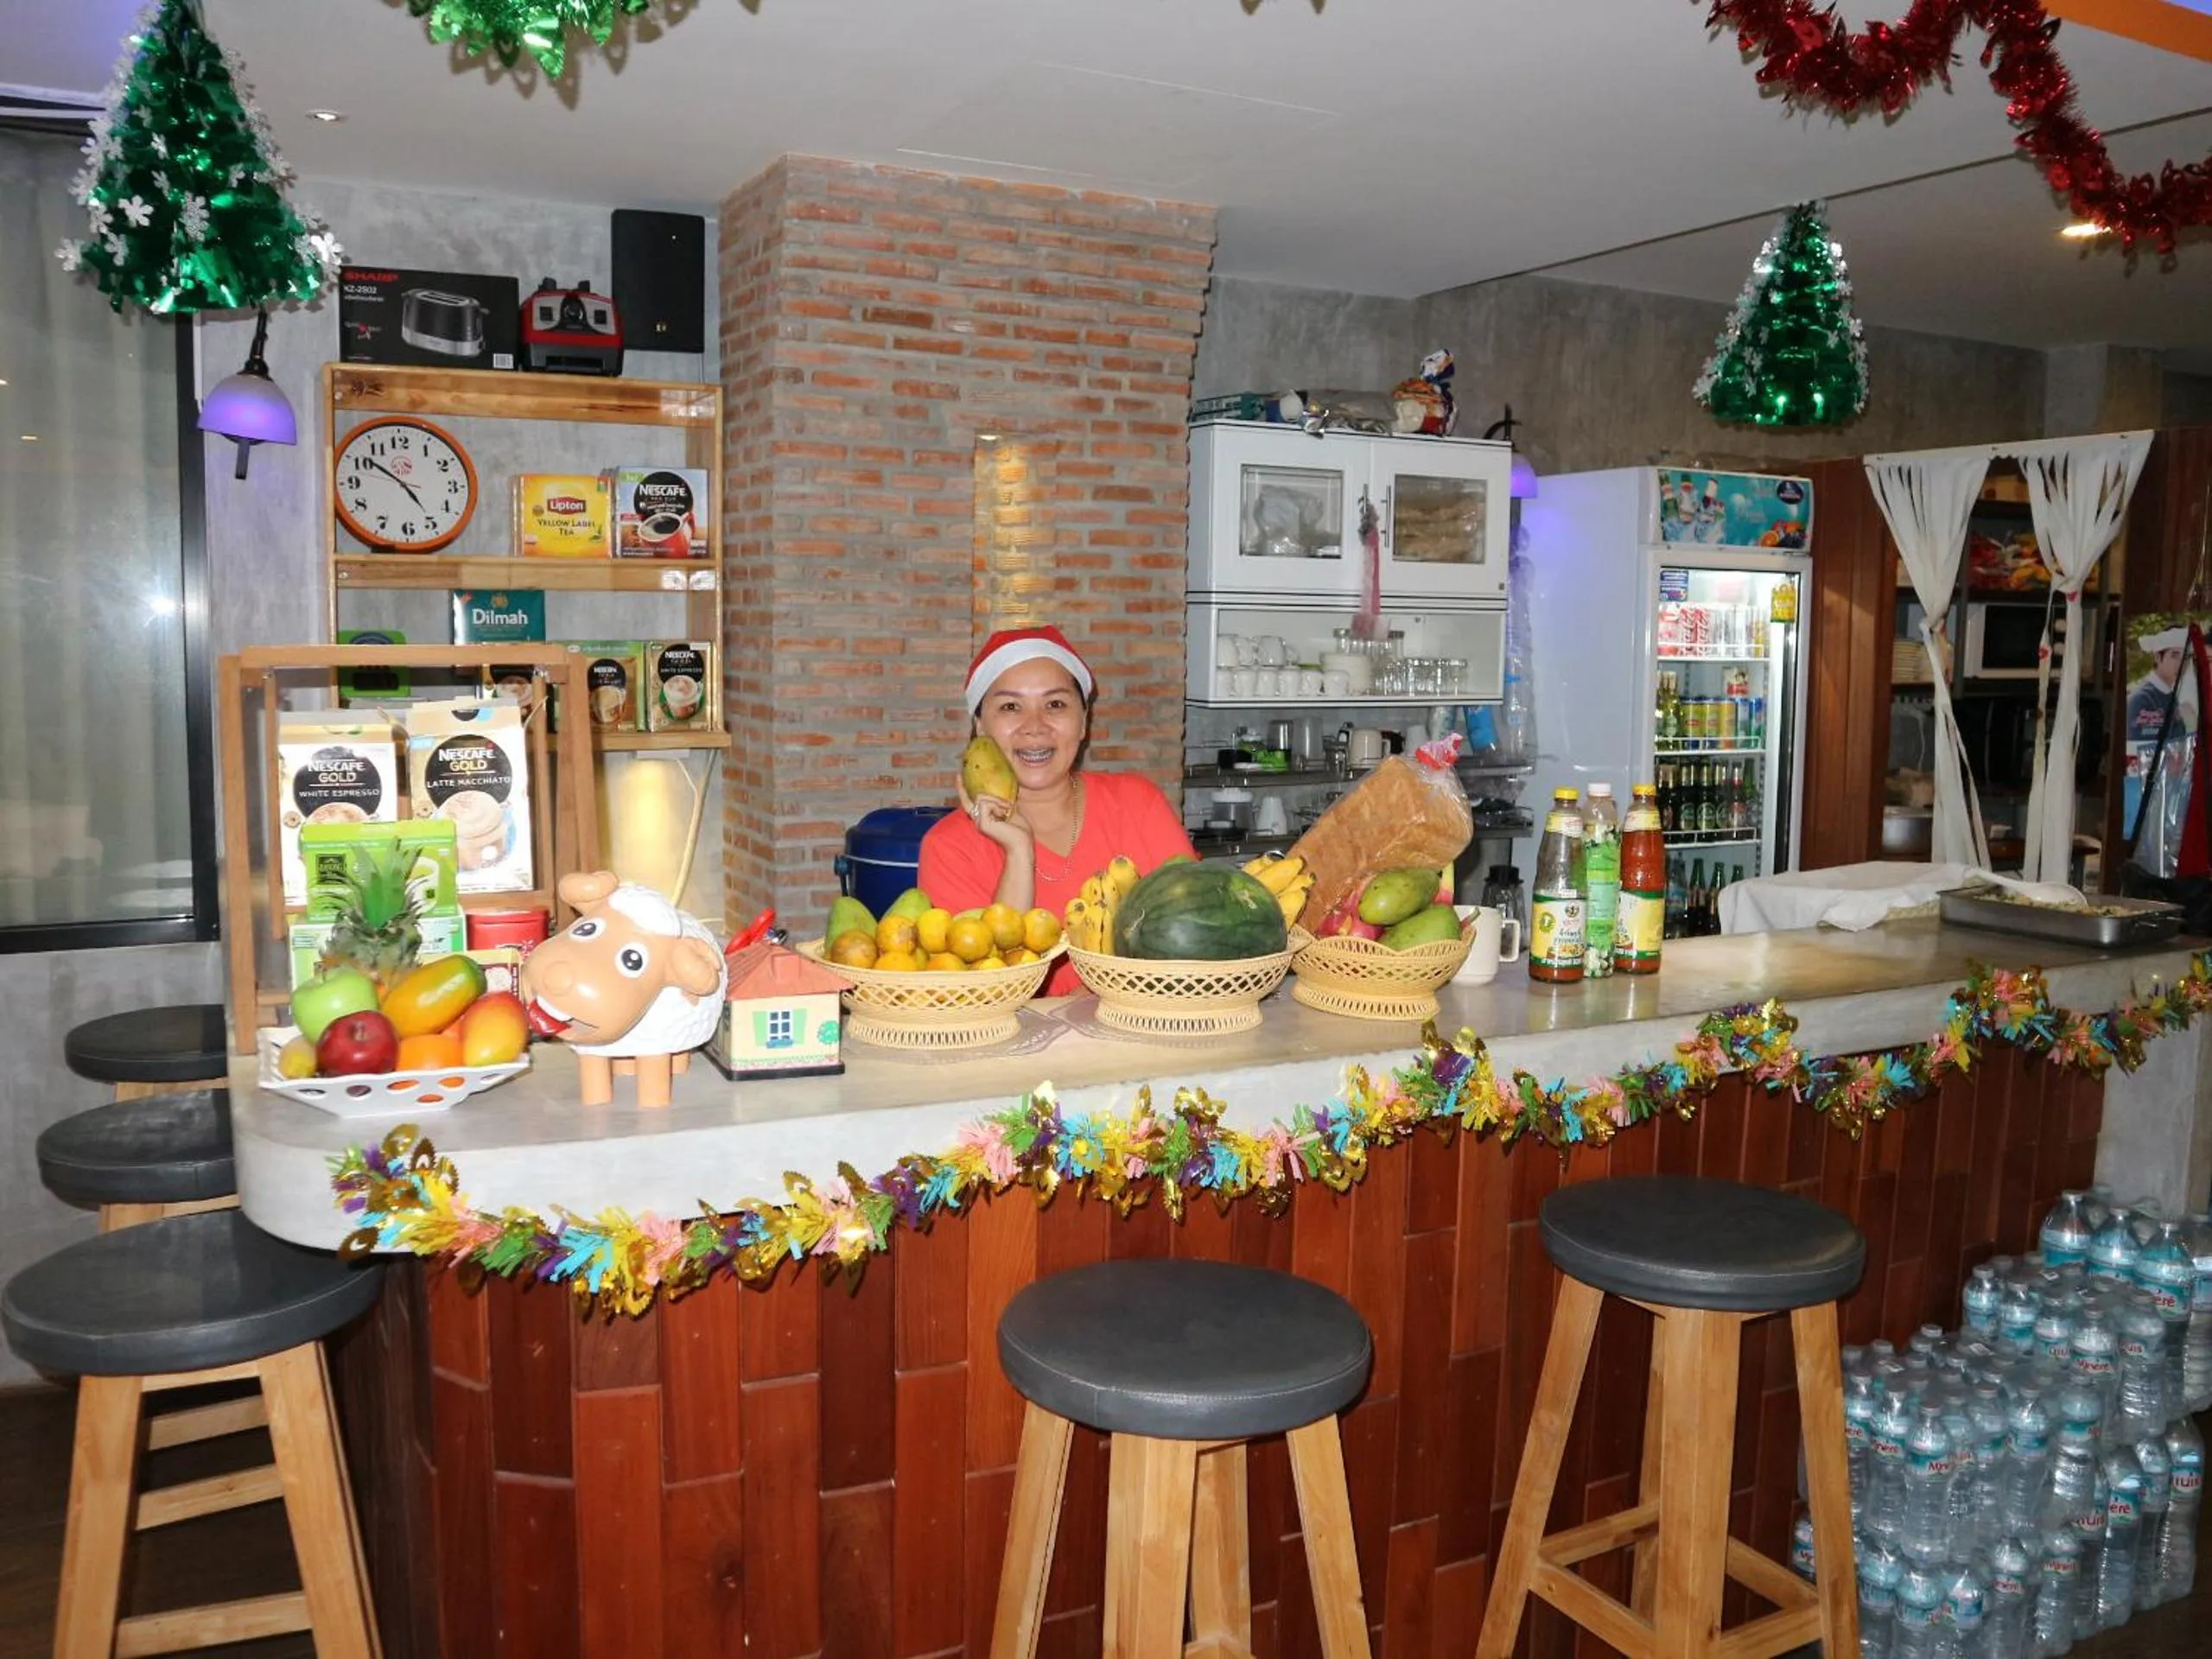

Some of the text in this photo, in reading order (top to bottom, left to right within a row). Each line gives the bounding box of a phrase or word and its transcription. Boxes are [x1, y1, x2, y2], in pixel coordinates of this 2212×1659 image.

[370, 442, 385, 456] 11
[391, 435, 410, 449] 12
[423, 444, 429, 457] 1
[354, 457, 373, 470] 10
[436, 459, 448, 473] 2
[347, 475, 360, 489] 9
[448, 480, 459, 494] 3
[354, 498, 367, 512] 8
[441, 499, 449, 513] 4
[550, 499, 583, 512] Lipton
[376, 515, 387, 530] 7
[402, 522, 415, 536] 6
[424, 517, 437, 530] 5
[472, 608, 529, 625] Dilmah
[449, 760, 488, 772] GOLD
[318, 772, 357, 784] GOLD
[426, 777, 512, 788] LATTE MACCHIATO
[331, 788, 380, 797] ESPRESSO
